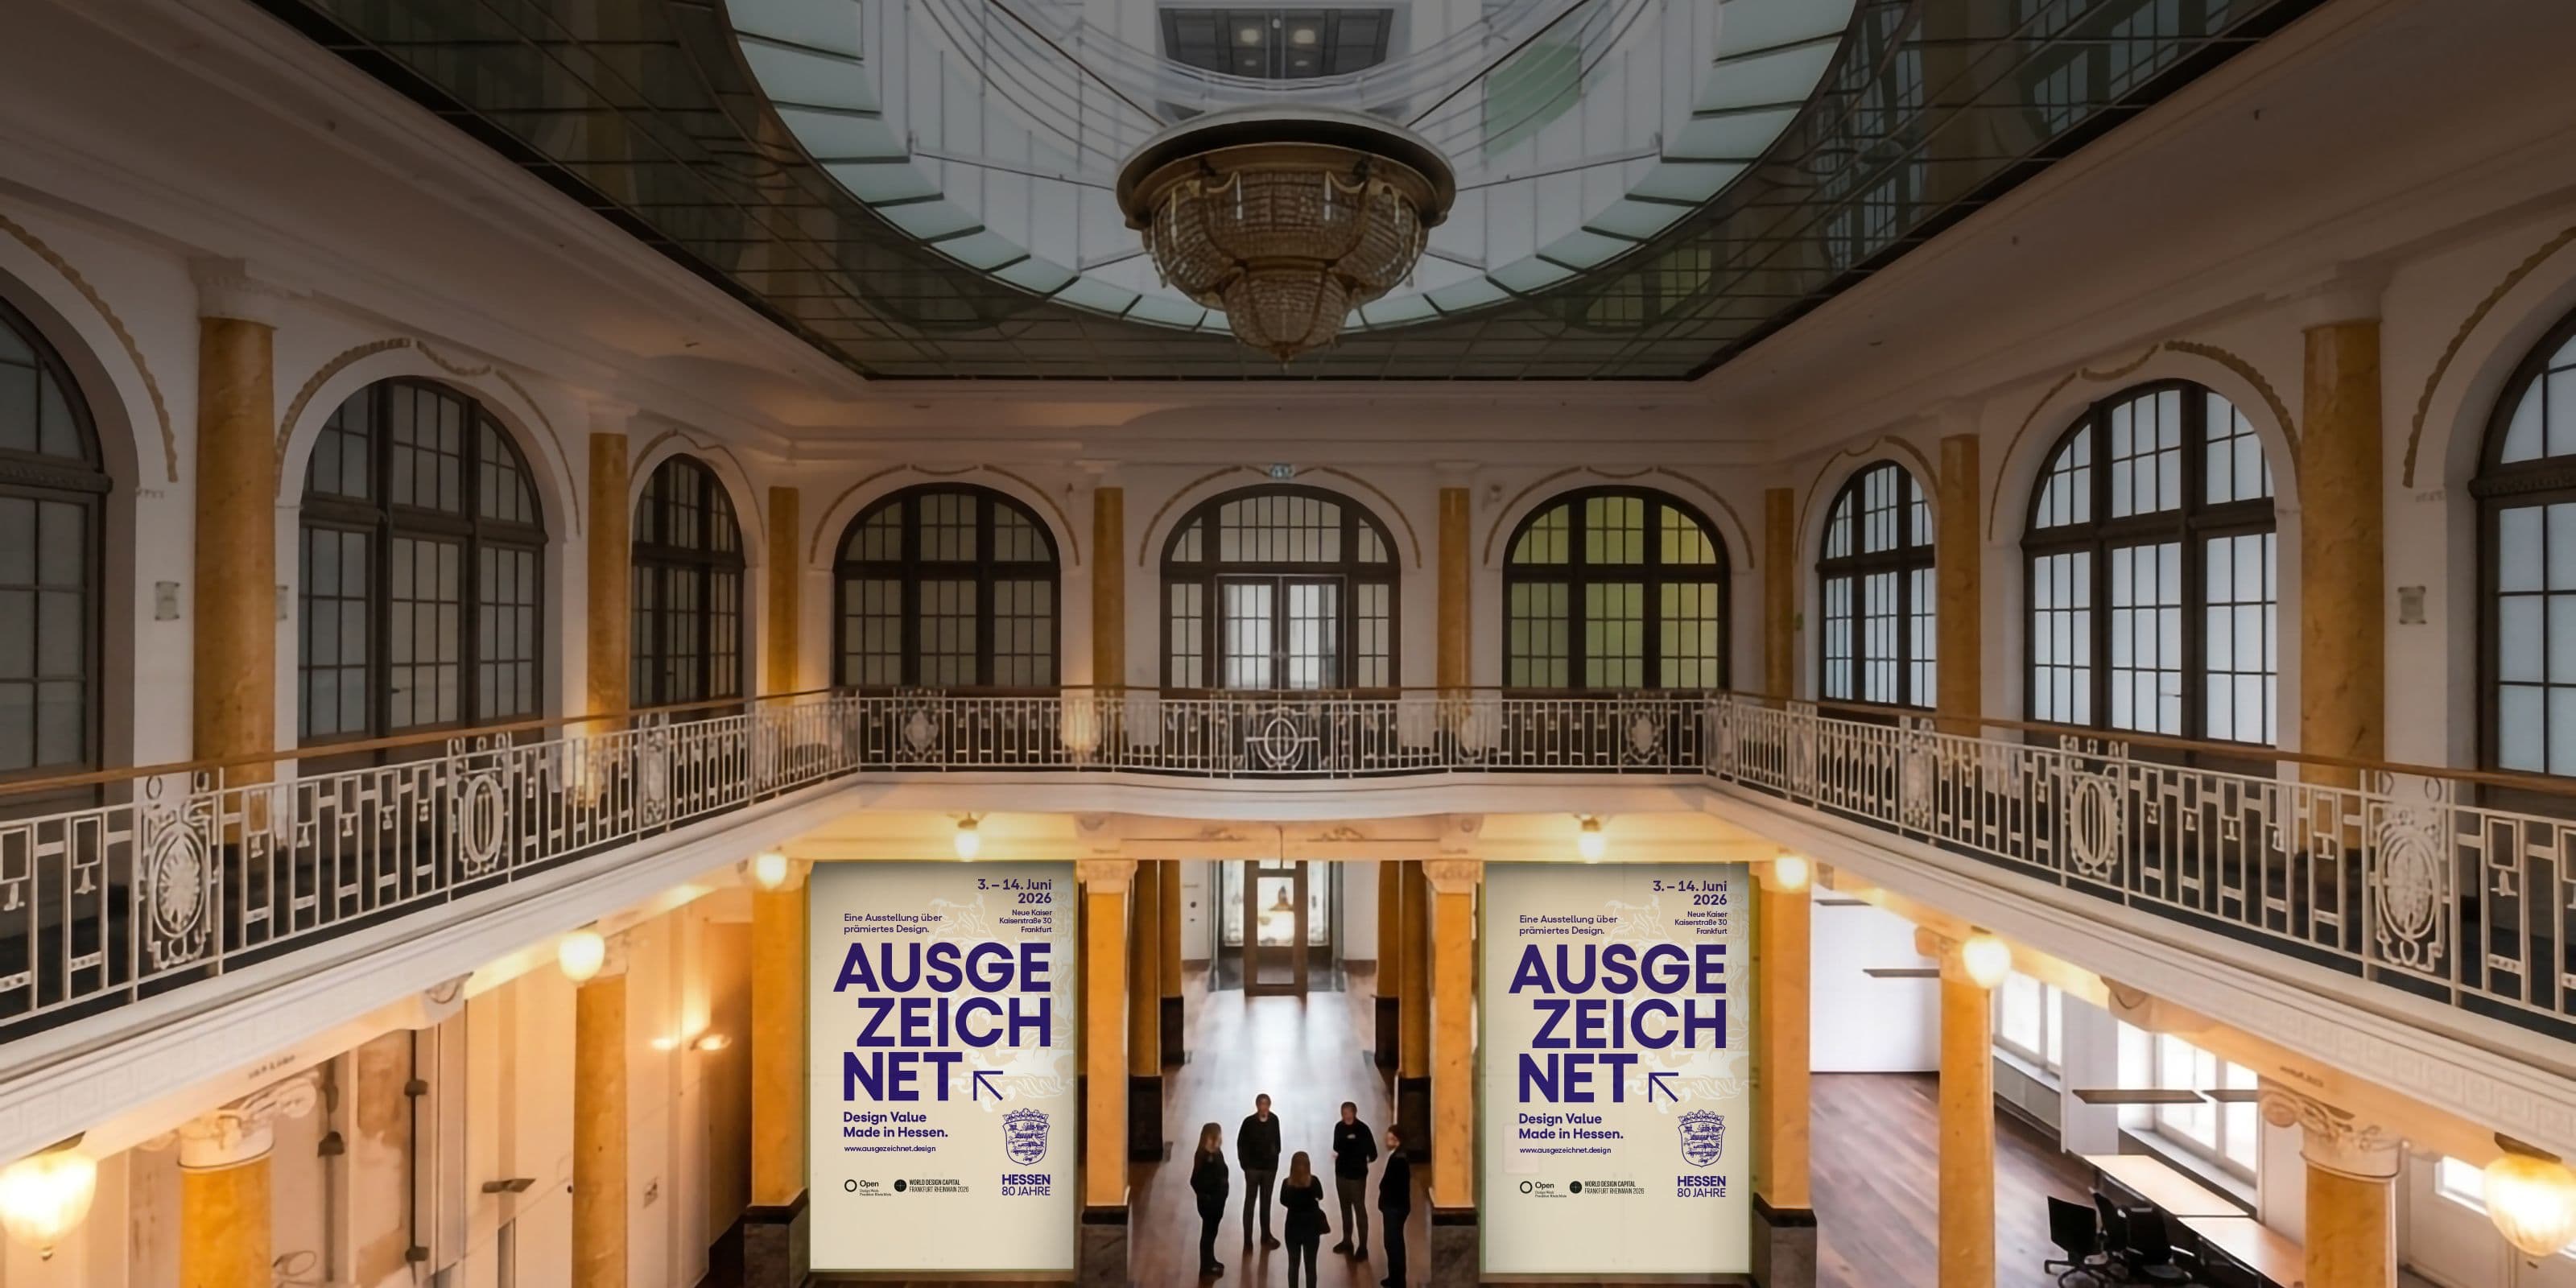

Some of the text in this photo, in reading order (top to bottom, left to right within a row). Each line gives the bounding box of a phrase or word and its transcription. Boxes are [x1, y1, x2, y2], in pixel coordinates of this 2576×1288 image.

[977, 878, 989, 890] 3.
[1002, 877, 1024, 890] 14.
[1026, 878, 1052, 890] Juni
[1653, 880, 1665, 892] 3.
[1678, 880, 1699, 892] 14.
[1701, 880, 1728, 892] Juni
[1018, 892, 1052, 904] 2026
[1693, 894, 1728, 906] 2026
[844, 913, 943, 923] Eine Ausstellung über
[1519, 914, 1618, 925] Eine Ausstellung über
[844, 924, 930, 935] prämiertes Design.
[1519, 926, 1605, 937] prämiertes Design.
[833, 942, 1051, 993] AUSGE
[1509, 944, 1726, 994] AUSGE
[857, 997, 1051, 1047] ZEICH
[1532, 999, 1726, 1049] ZEICH
[844, 1052, 963, 1101] NET
[1519, 1054, 1637, 1102] NET
[843, 1111, 927, 1125] Design Value
[1518, 1113, 1603, 1127] Design Value
[843, 1125, 948, 1137] Made in Hessen.
[1518, 1127, 1624, 1139] Made in Hessen.
[844, 1145, 936, 1154] www.ausgezeichnet.design
[1519, 1146, 1612, 1155] www.ausgezeichnet.design
[859, 1179, 879, 1189] Open
[1001, 1174, 1051, 1186] HESSEN
[1534, 1181, 1554, 1191] Open
[1677, 1175, 1727, 1187] HESSEN
[1001, 1186, 1051, 1196] 80 JAHRE
[1677, 1187, 1727, 1198] 80 JAHRE
